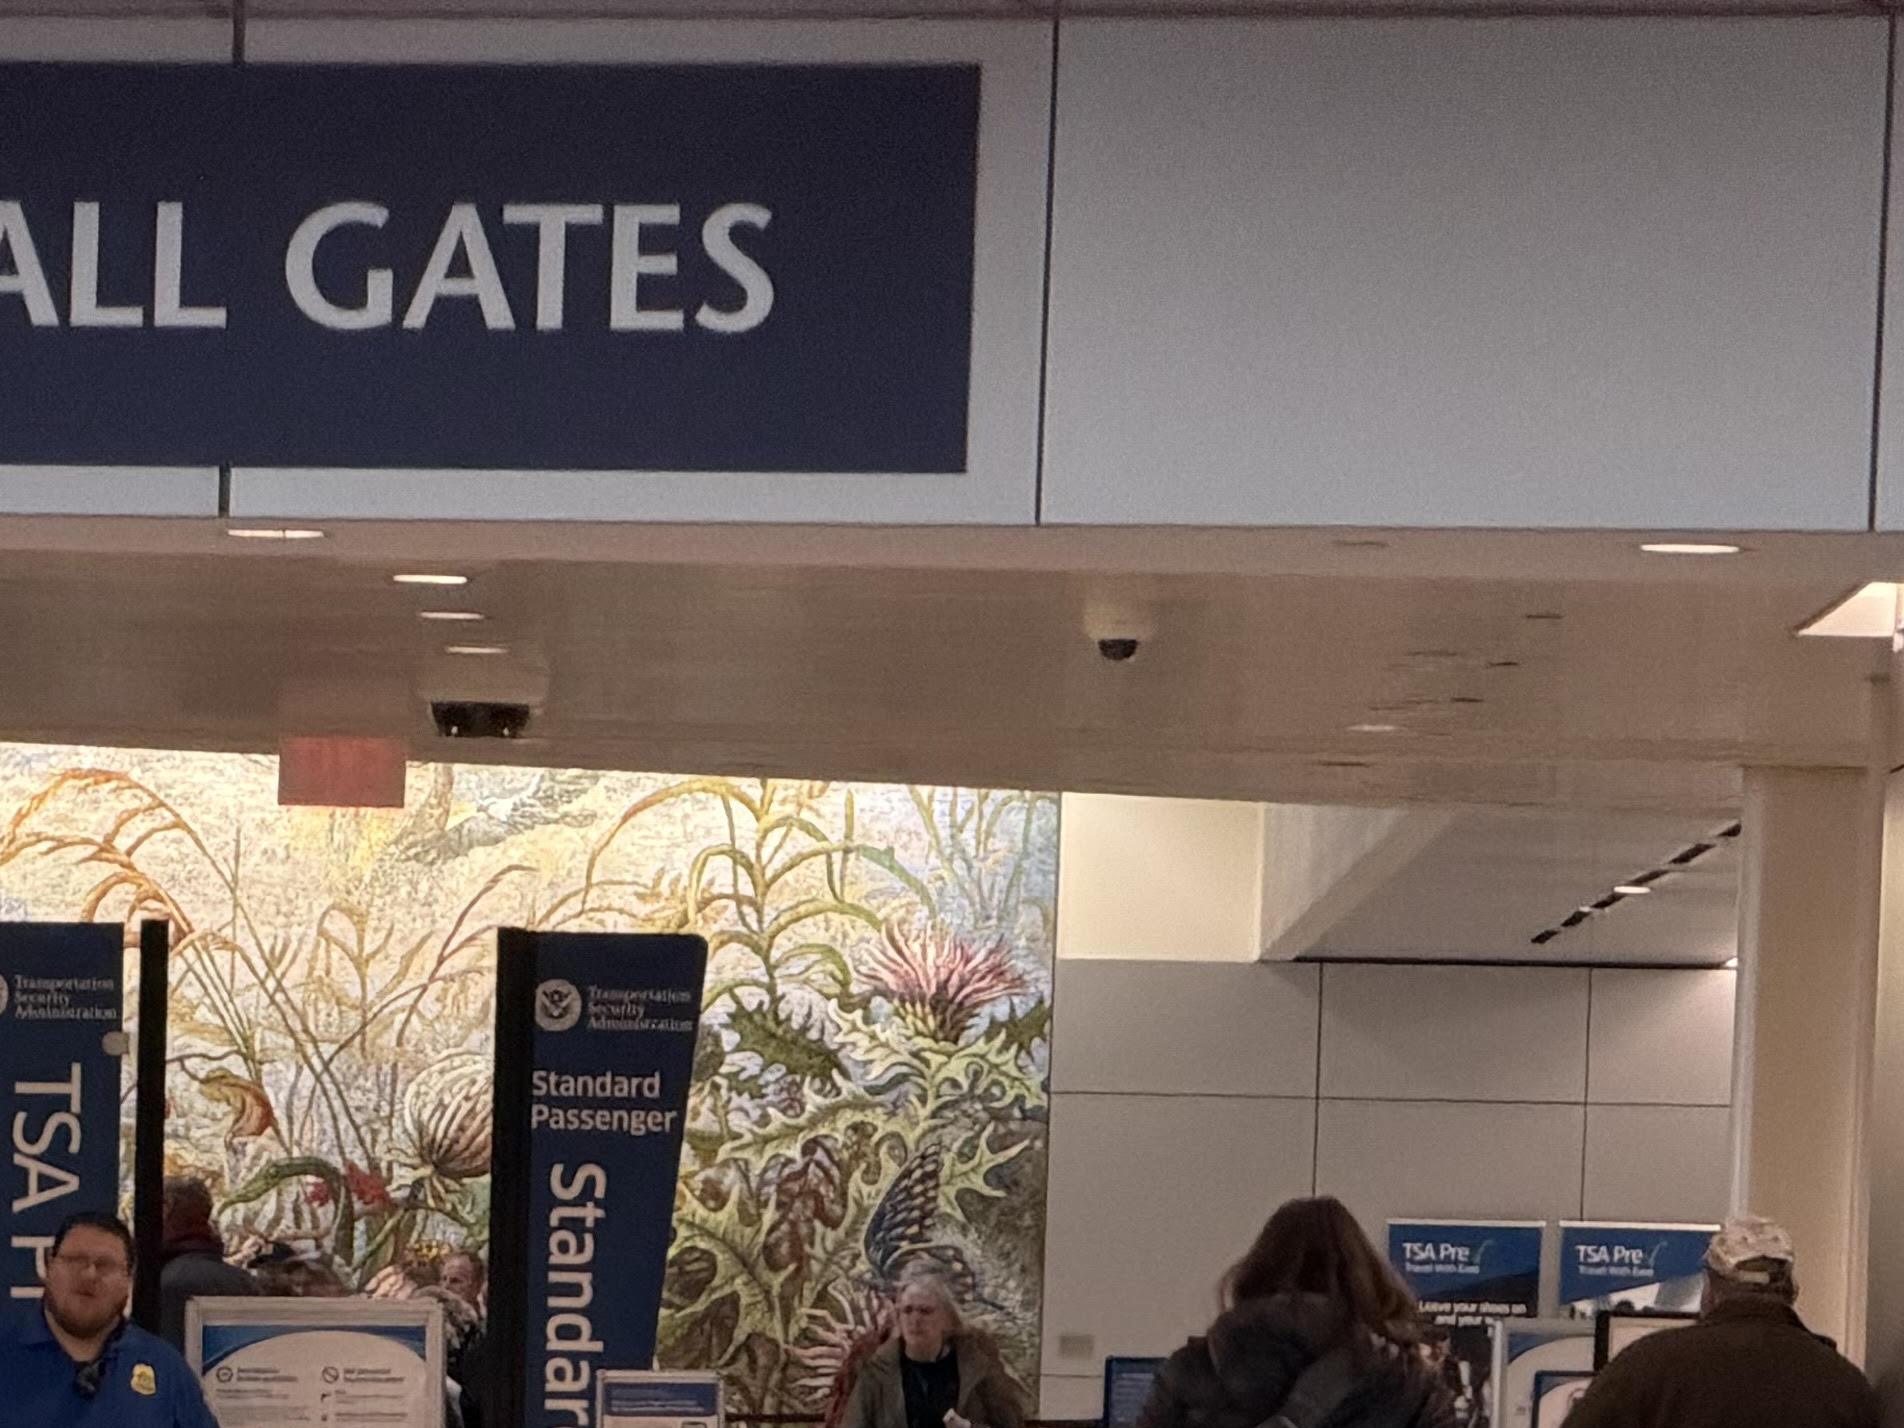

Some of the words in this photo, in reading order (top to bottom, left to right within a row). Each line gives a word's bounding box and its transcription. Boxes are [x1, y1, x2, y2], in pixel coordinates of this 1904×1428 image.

[283, 200, 776, 333] GATES
[532, 1070, 661, 1098] Standard
[530, 1103, 678, 1136] Passenger
[12, 1062, 82, 1214] TSA
[1402, 1242, 1436, 1262] TSA
[1439, 1242, 1470, 1262] Pre
[1575, 1244, 1610, 1264] TSA
[1613, 1244, 1643, 1265] Pre
[1453, 1302, 1477, 1316] your
